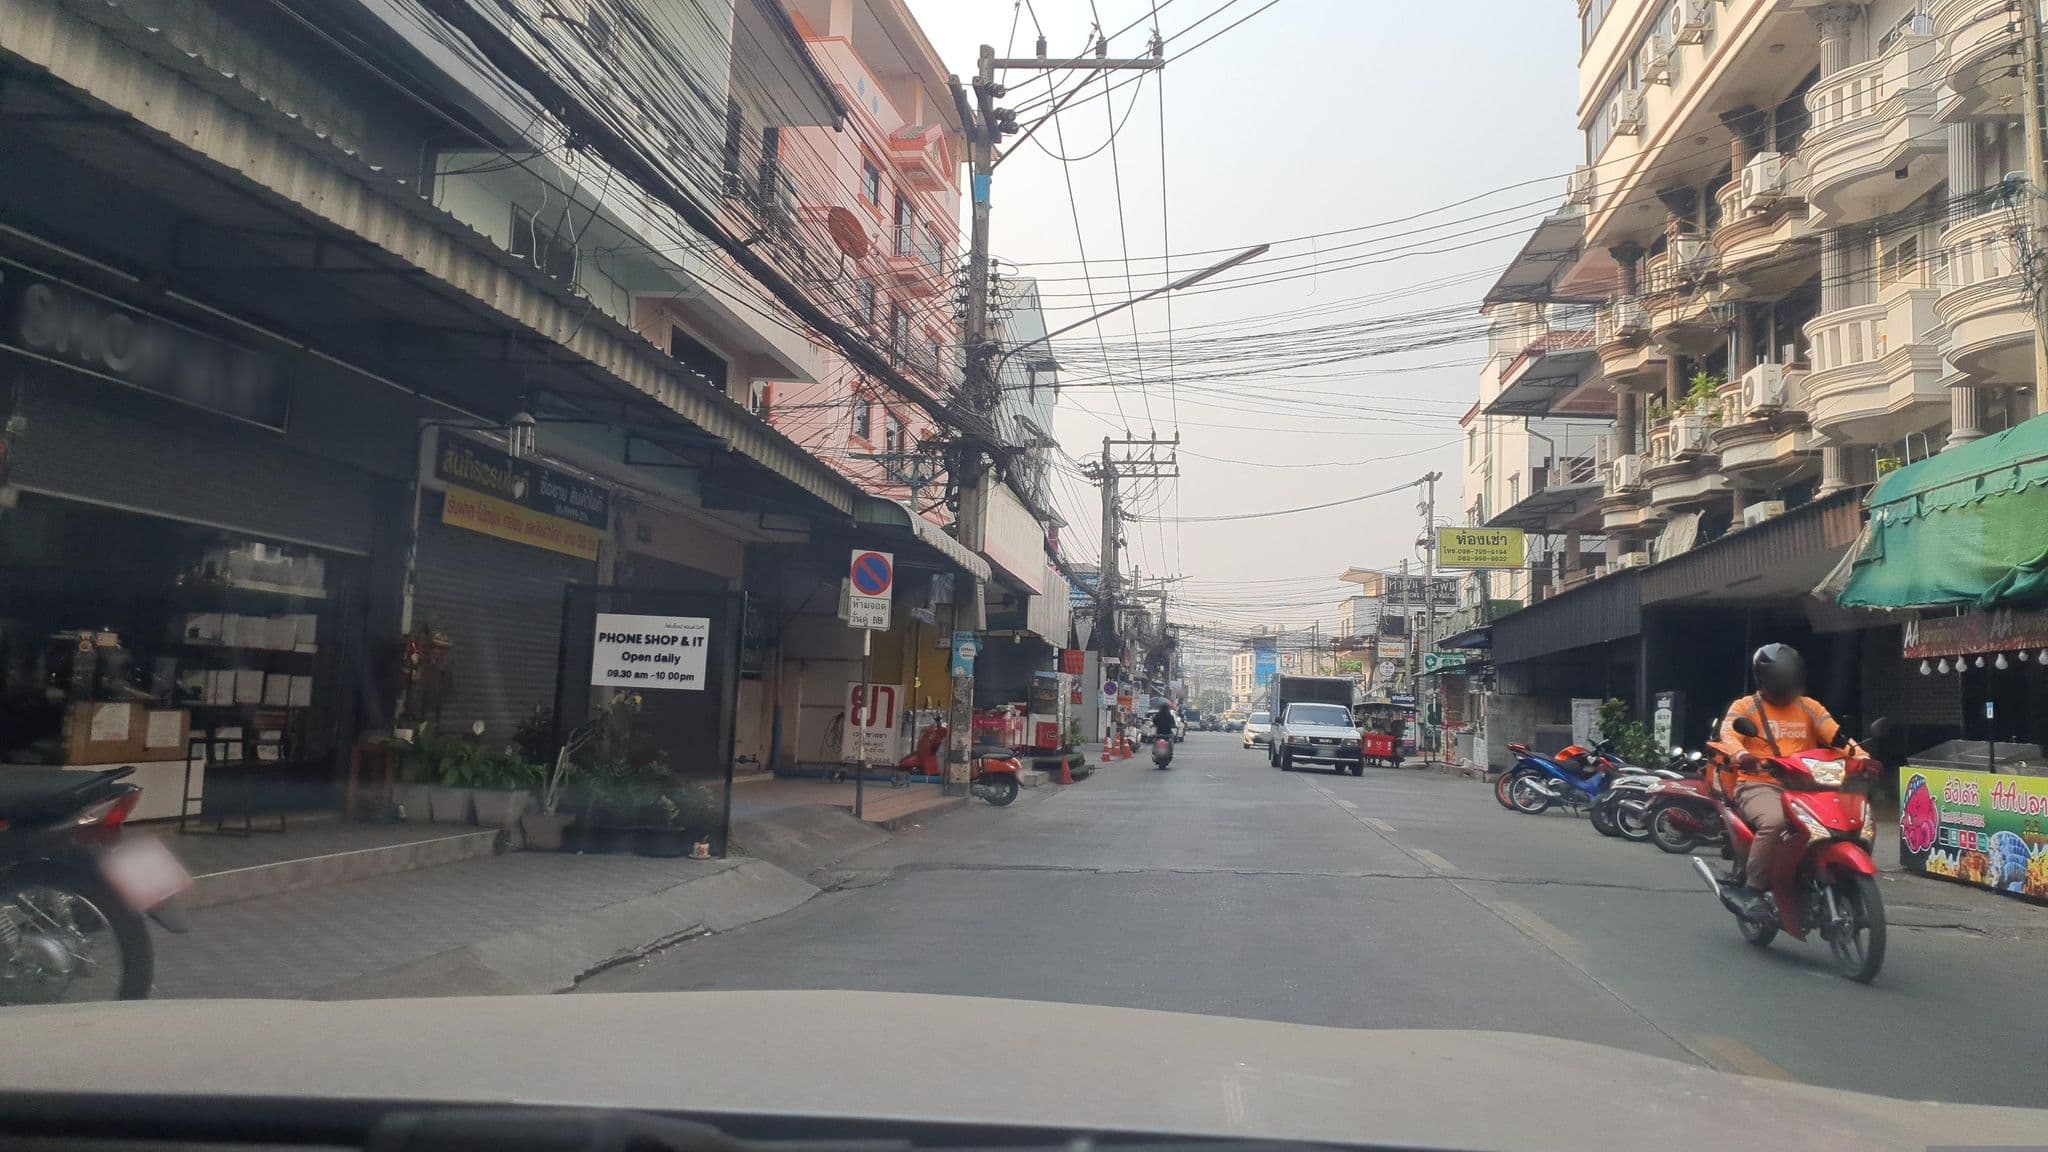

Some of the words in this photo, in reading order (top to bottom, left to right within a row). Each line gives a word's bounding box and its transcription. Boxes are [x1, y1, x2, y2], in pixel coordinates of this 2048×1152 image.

[1456, 531, 1507, 546] ห้องเช่า
[853, 597, 887, 610] ห้ามจอด
[851, 611, 869, 626] วันคู่
[599, 632, 642, 644] PHONE
[645, 634, 679, 646] SHOP
[681, 636, 690, 647] &
[693, 637, 704, 647] IT
[622, 651, 652, 663] Open
[654, 653, 681, 665] daily
[634, 671, 648, 679] am
